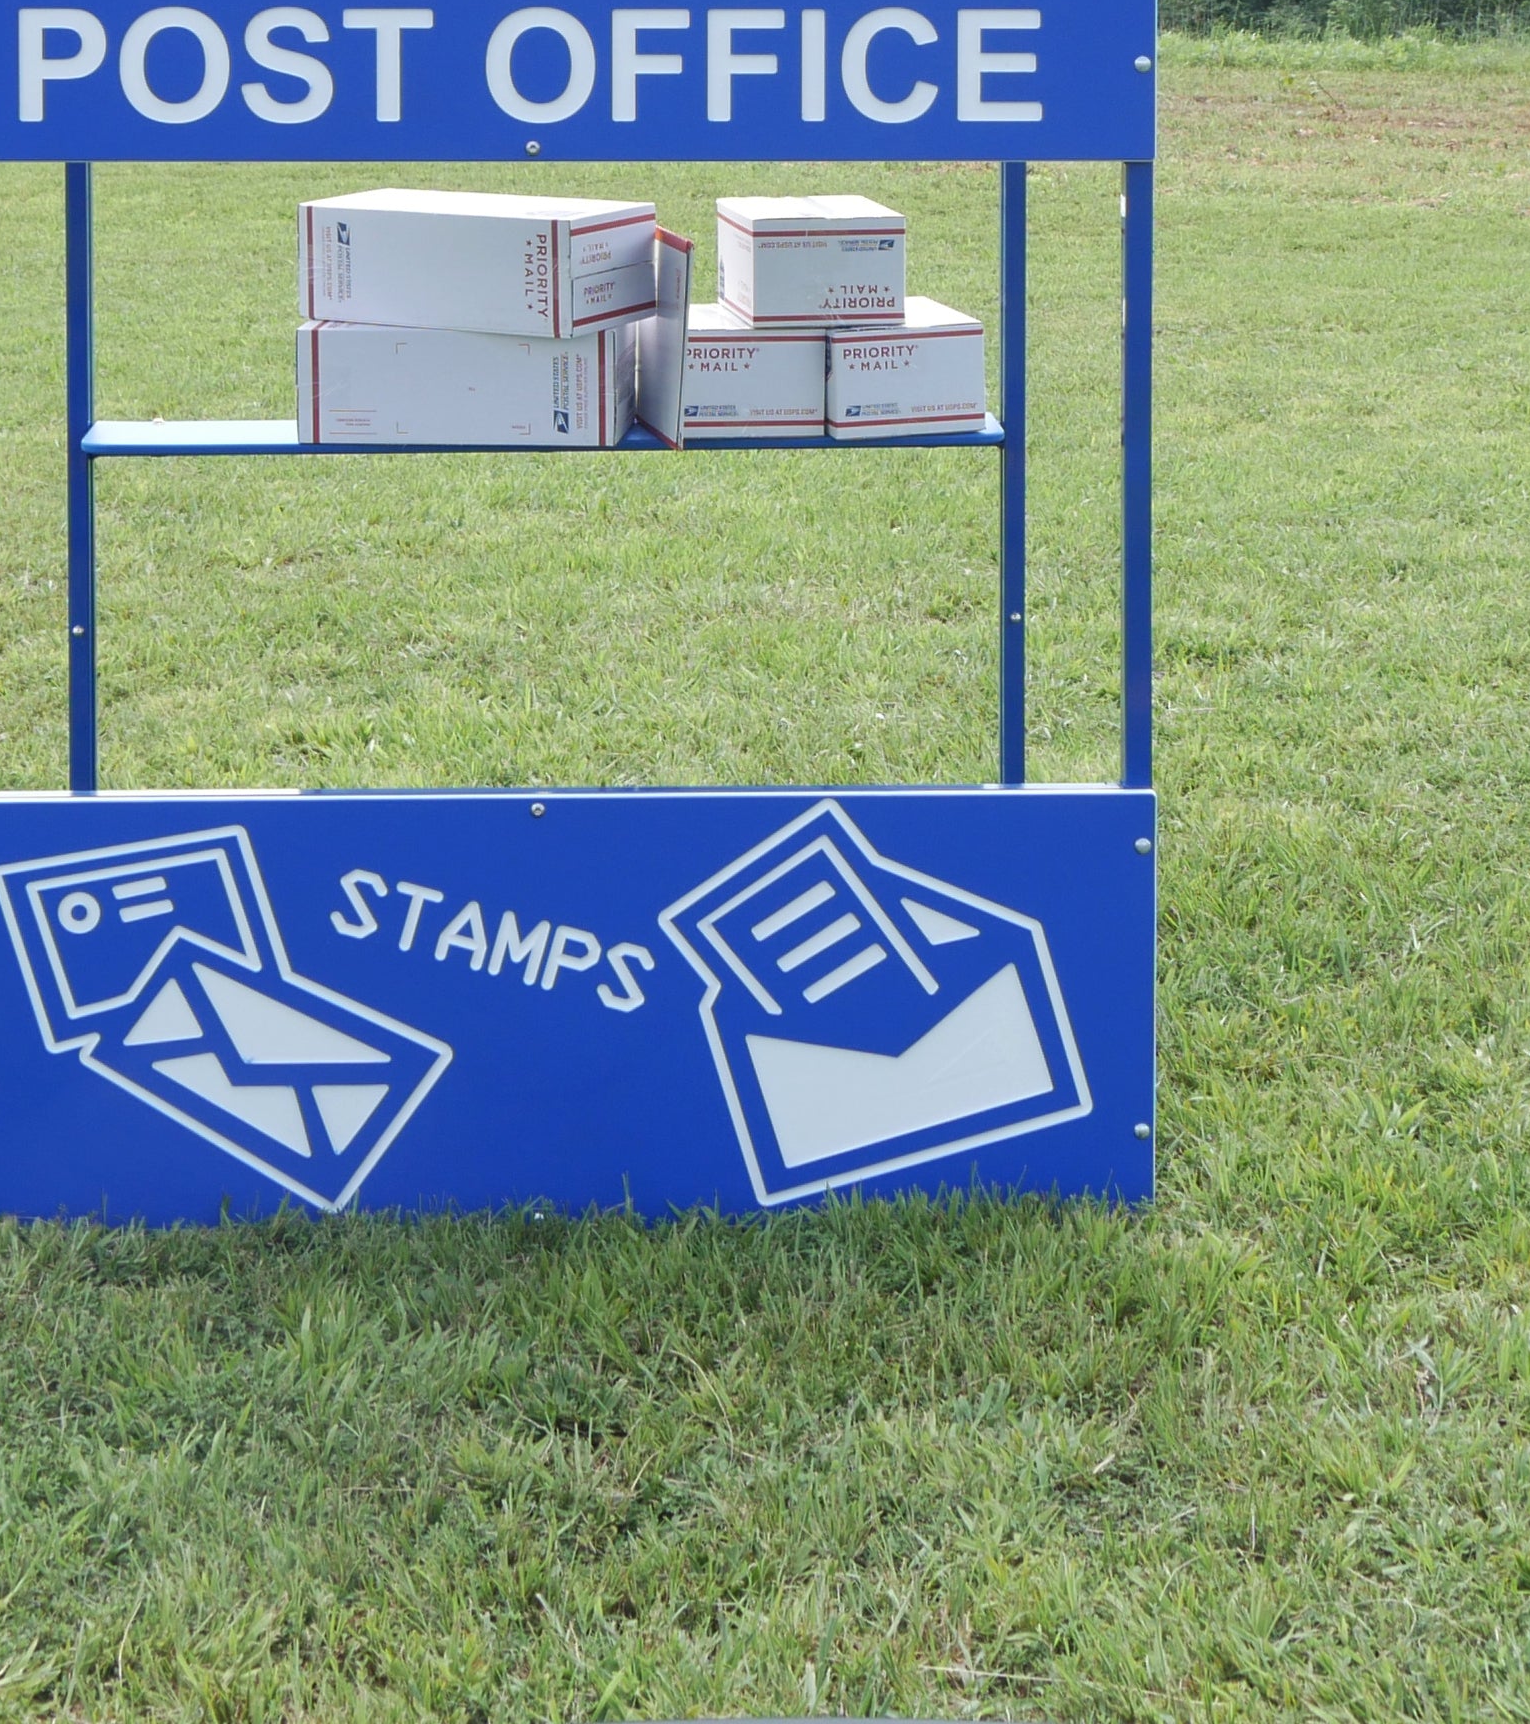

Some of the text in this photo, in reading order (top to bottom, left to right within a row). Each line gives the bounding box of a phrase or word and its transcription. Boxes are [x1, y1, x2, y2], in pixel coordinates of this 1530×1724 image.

[19, 7, 1042, 124] POST OFFICE
[524, 252, 534, 297] MAIL
[536, 234, 549, 318] PRIORITY
[583, 282, 615, 295] PRIORITY
[840, 284, 878, 294] MAIL
[590, 294, 607, 304] MAIL
[821, 297, 895, 309] PRIORITY
[843, 344, 915, 360] PRIORITY
[700, 362, 738, 372] MAIL
[861, 359, 899, 371] MAIL
[330, 868, 655, 1012] STAMPS
